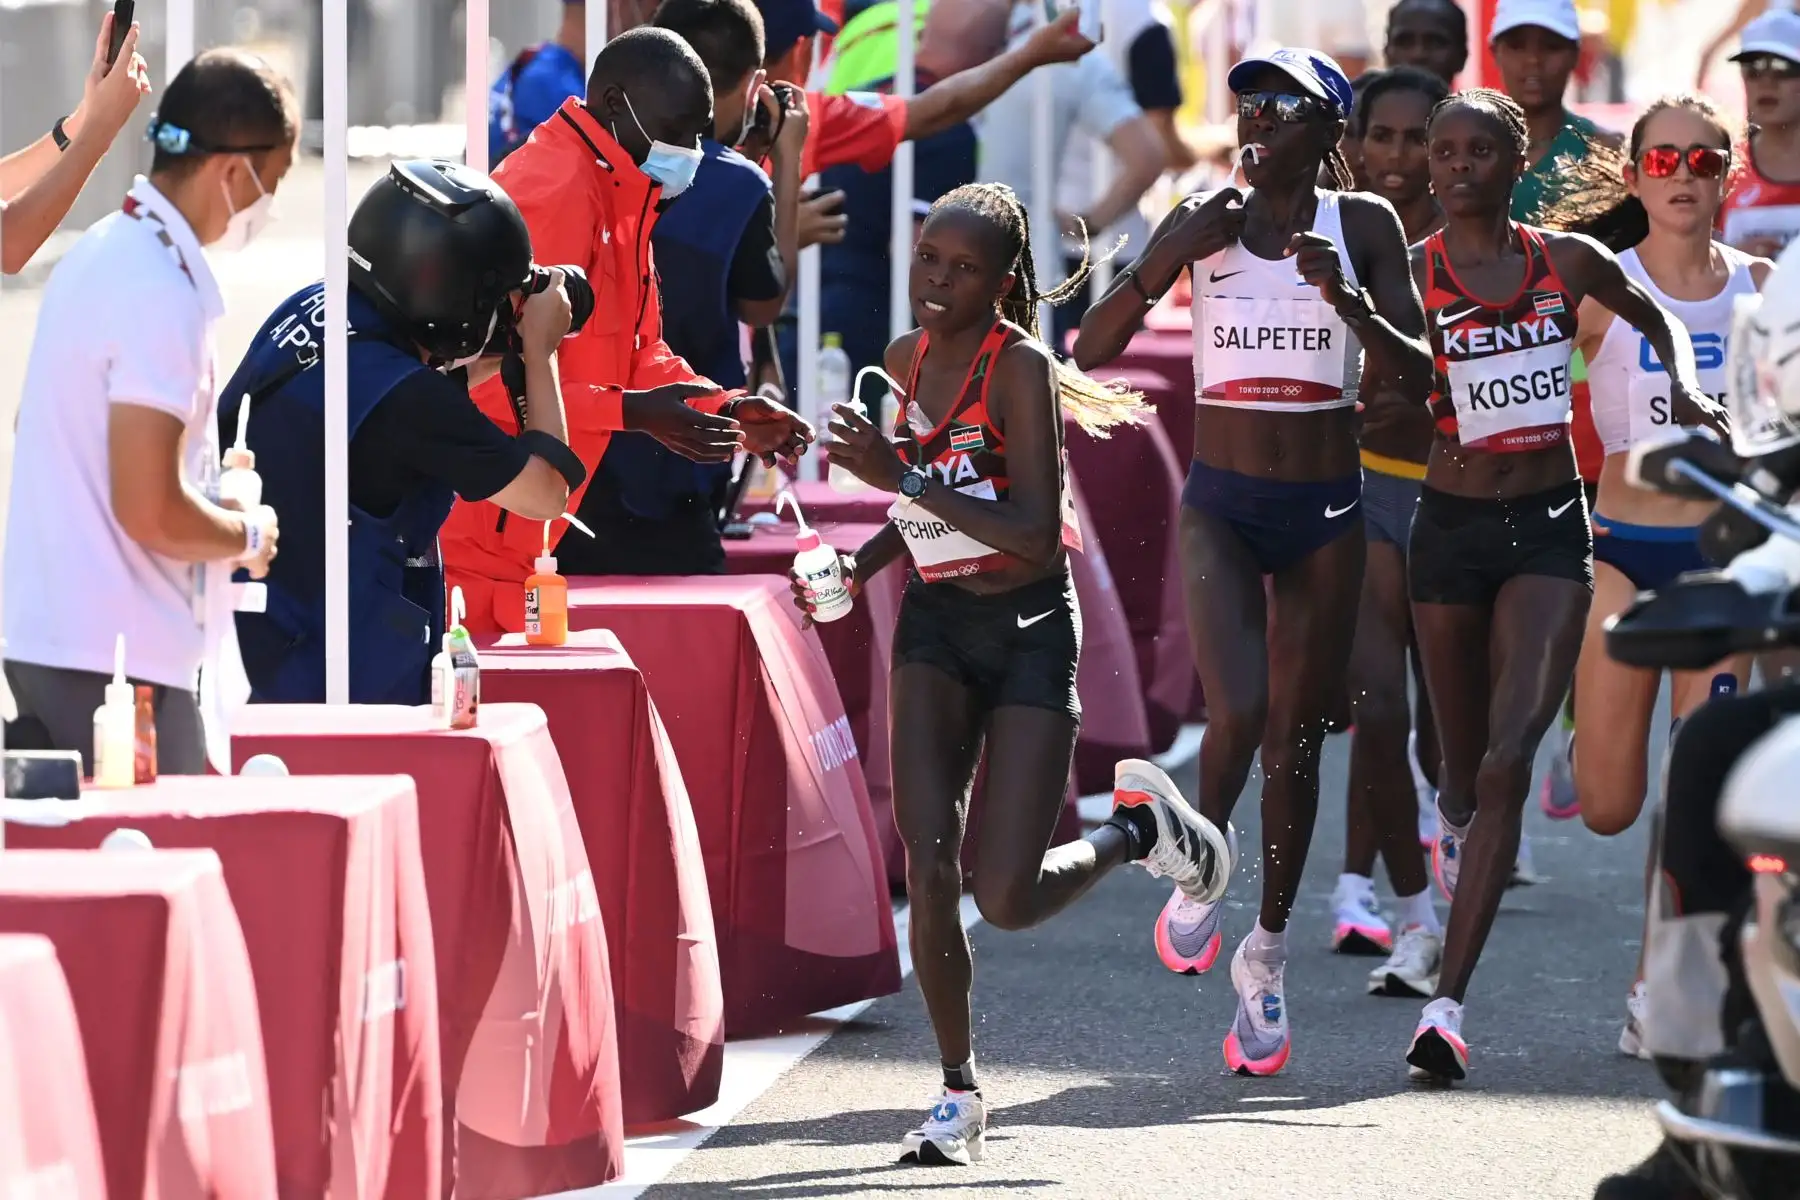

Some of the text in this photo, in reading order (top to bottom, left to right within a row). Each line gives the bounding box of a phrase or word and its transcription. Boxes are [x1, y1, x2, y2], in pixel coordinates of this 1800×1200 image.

[1213, 325, 1332, 351] SALPETER
[1442, 316, 1563, 355] KENYA
[1638, 326, 1729, 373] US
[1238, 386, 1279, 394] TOKYO 2020
[1502, 434, 1541, 445] TOKYO 2020
[921, 569, 959, 580] TOKYO 2020
